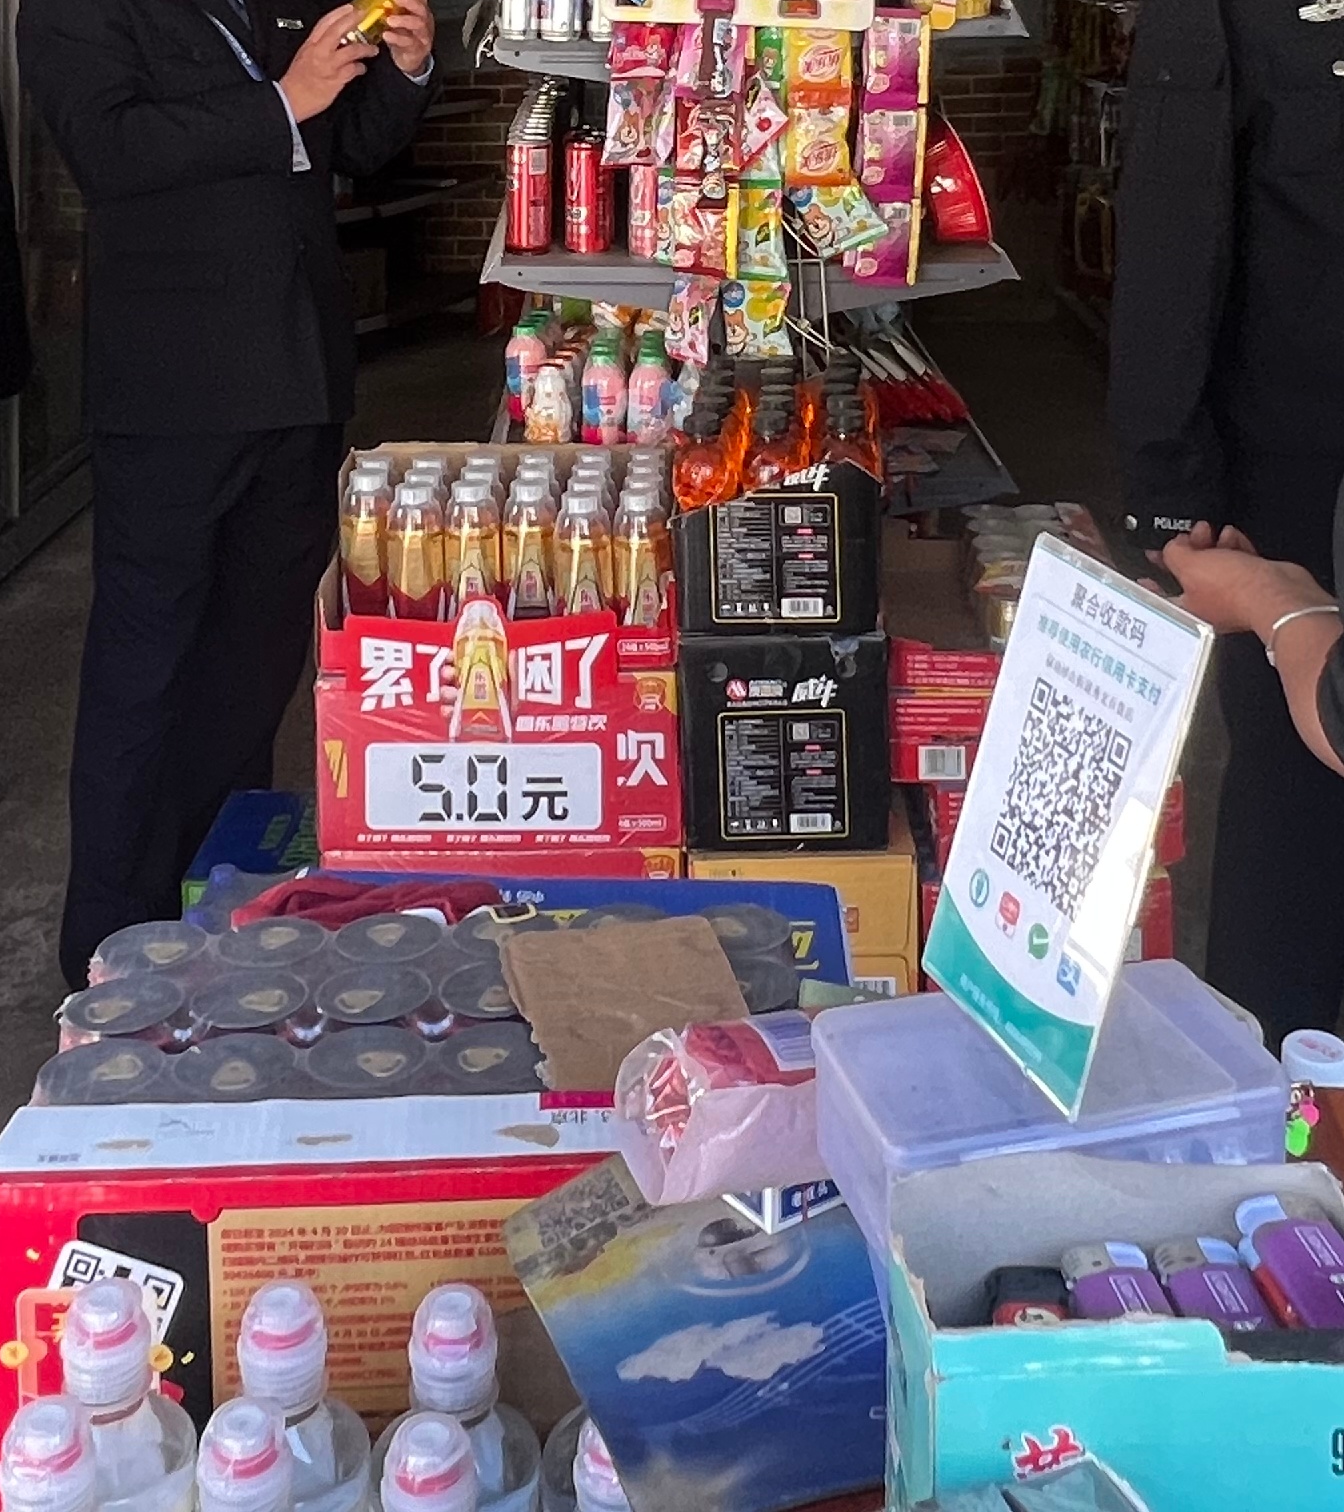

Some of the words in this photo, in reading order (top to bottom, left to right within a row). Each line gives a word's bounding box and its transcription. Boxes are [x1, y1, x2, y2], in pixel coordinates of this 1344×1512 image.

[1154, 516, 1192, 532] POLICE
[1070, 582, 1148, 648] 聚合收款码
[360, 636, 452, 713] 累了
[518, 632, 610, 709] 困了
